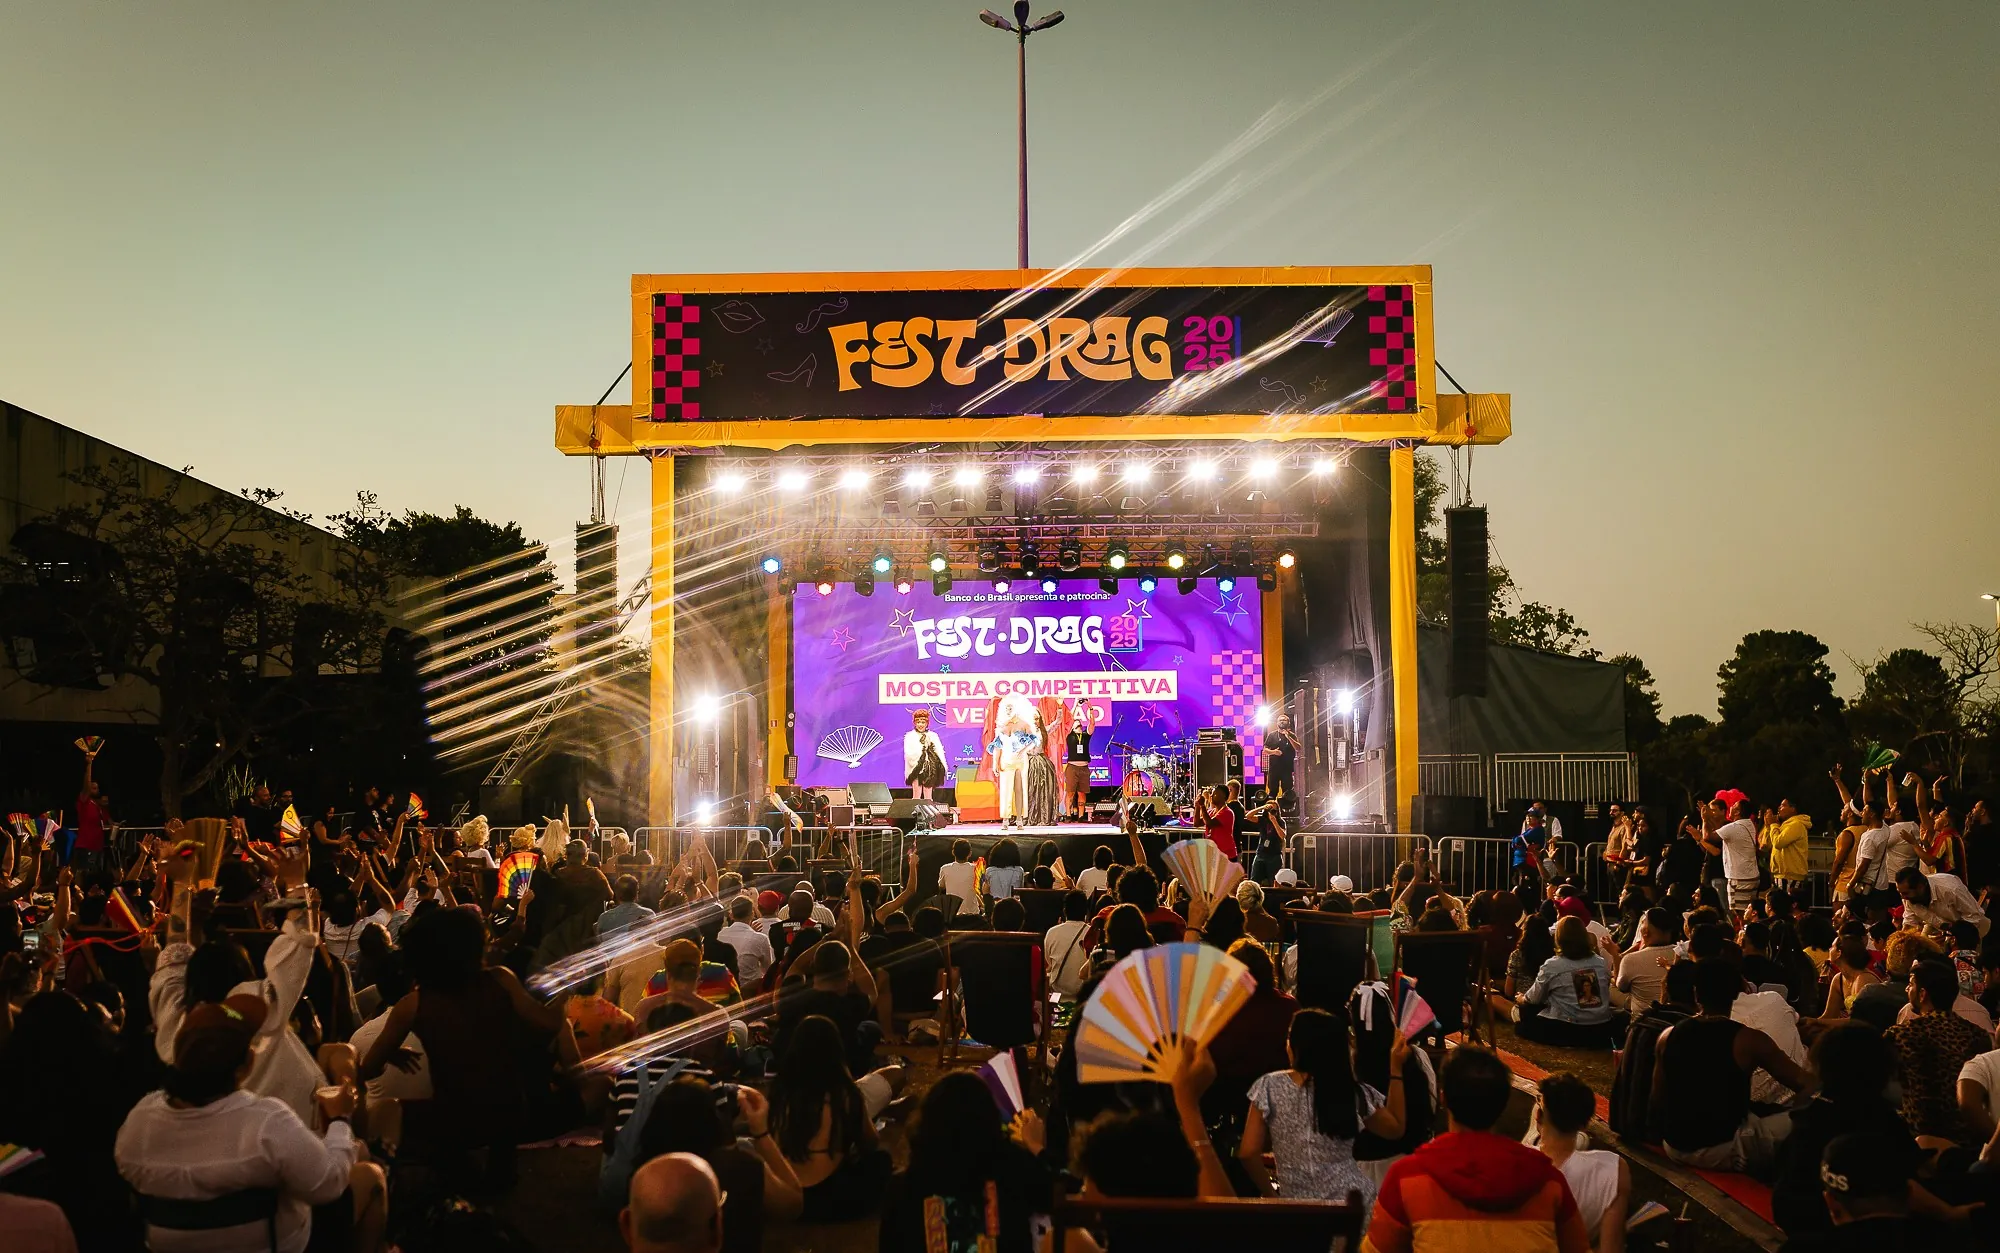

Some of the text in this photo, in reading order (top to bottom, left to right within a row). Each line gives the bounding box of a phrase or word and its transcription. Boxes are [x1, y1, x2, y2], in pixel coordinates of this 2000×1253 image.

[1183, 315, 1234, 343] 20
[1183, 343, 1232, 371] 25
[944, 593, 972, 602] Banco
[974, 593, 986, 601] do
[987, 592, 1014, 601] Brasil
[1014, 592, 1058, 602] apresenta
[1066, 592, 1111, 602] patrocina:
[1109, 615, 1139, 633] 20
[1109, 632, 1138, 648] 25
[886, 678, 1172, 698] MOSTRA COMPETITIVA
